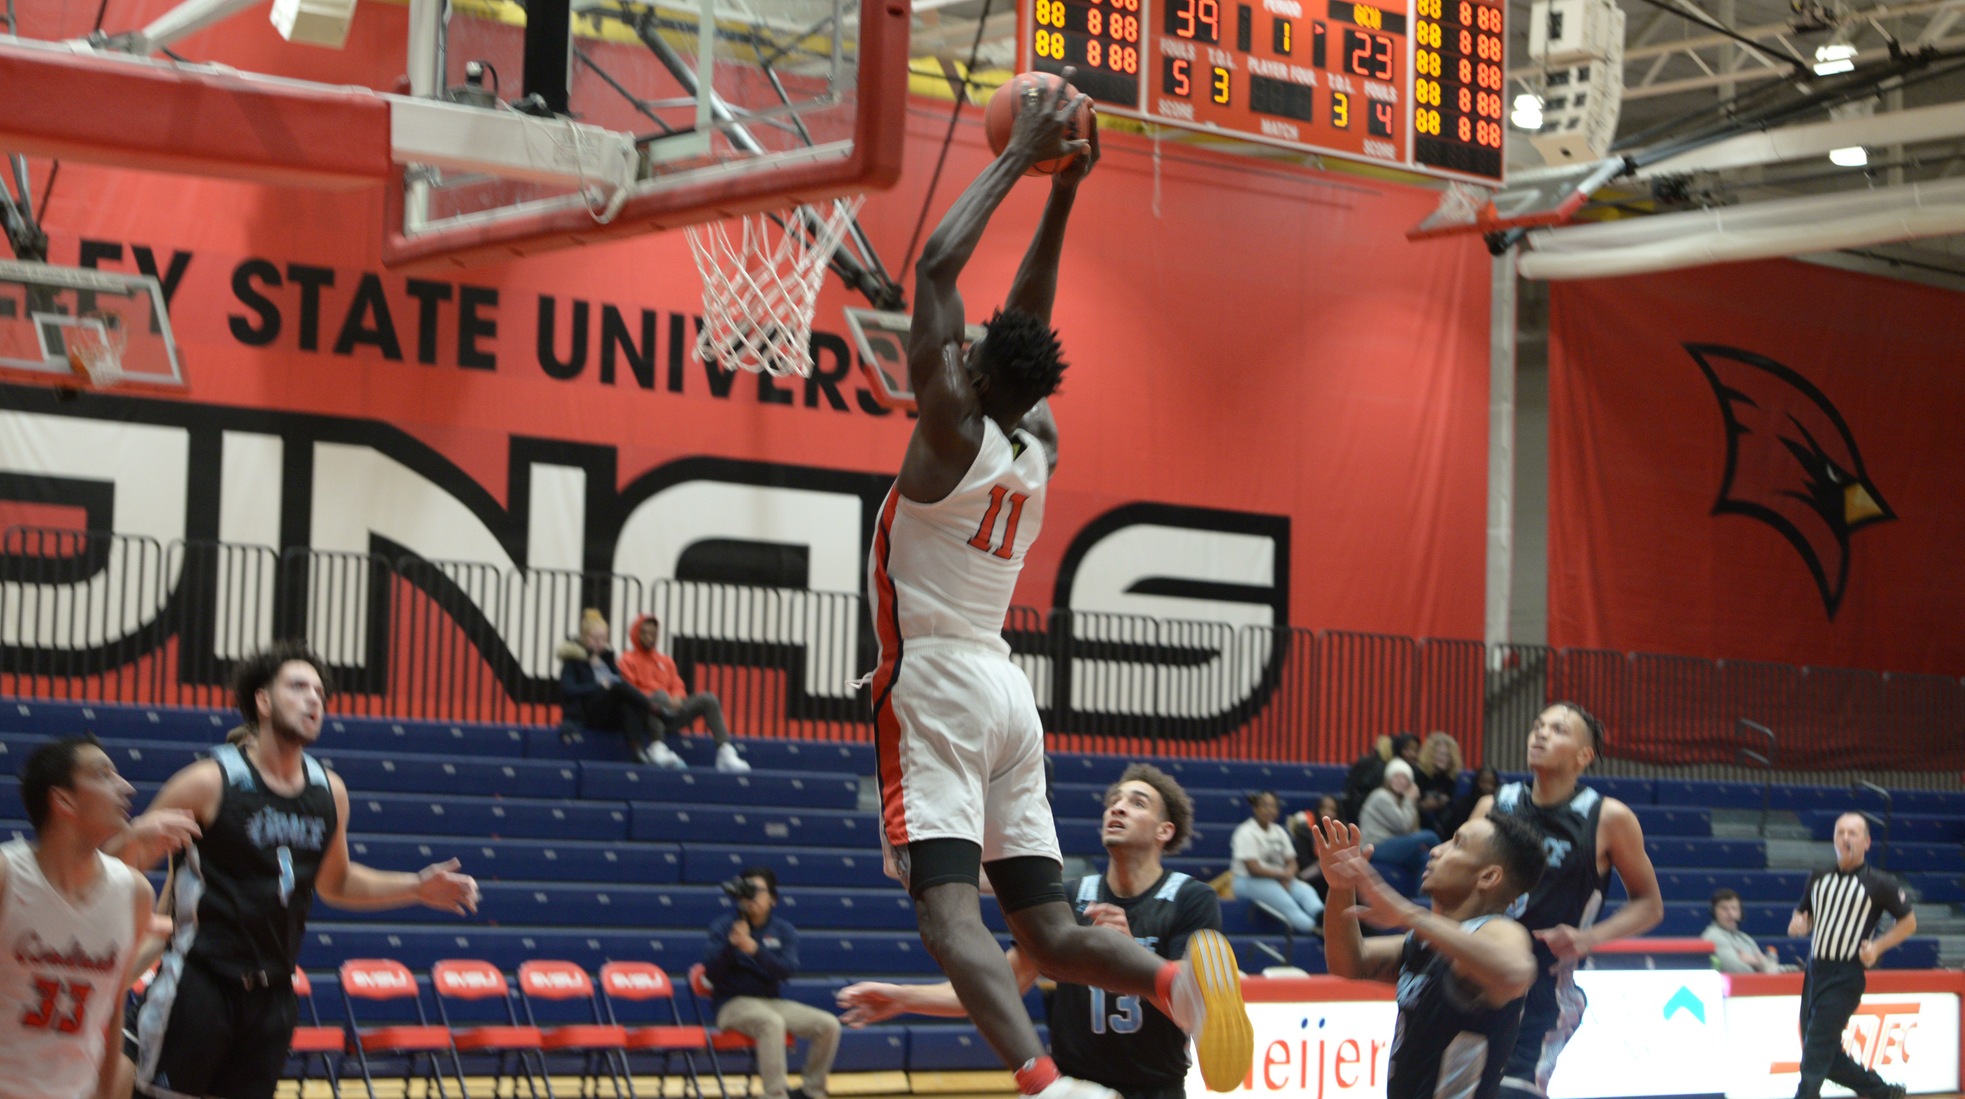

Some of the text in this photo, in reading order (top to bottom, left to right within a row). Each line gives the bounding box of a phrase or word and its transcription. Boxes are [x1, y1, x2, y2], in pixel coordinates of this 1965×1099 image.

[1035, 0, 1066, 28] 88
[1087, 8, 1102, 36] 8
[1109, 12, 1138, 43] 88
[1175, 0, 1219, 41] 39
[1283, 22, 1291, 52] 1
[1459, 1, 1472, 27] 8
[1477, 5, 1502, 33] 88
[1035, 29, 1138, 75] 88 8 88
[1159, 38, 1197, 61] FOULS
[1352, 31, 1393, 81] 23
[1416, 20, 1502, 62] 88 8 88
[1172, 59, 1190, 96] 5
[1214, 67, 1229, 104] 3
[1247, 55, 1319, 87] PLAYER FOUL
[1416, 49, 1502, 91] 88 8 88
[1158, 98, 1195, 121] SCORE
[1333, 92, 1348, 128] 3
[1363, 80, 1398, 104] FOULS
[1416, 78, 1502, 120] 88 8 88
[1260, 118, 1299, 141] MATCH
[1376, 103, 1392, 135] 4
[1415, 107, 1501, 149] 88 8 88
[1362, 138, 1398, 161] SCORE
[228, 258, 498, 371] STATE
[536, 294, 920, 419] UNIVERS
[967, 484, 1030, 560] 11
[276, 845, 295, 908] 1
[20, 975, 97, 1036] 33
[1088, 985, 1144, 1035] 13
[1240, 1017, 1387, 1099] eijer
